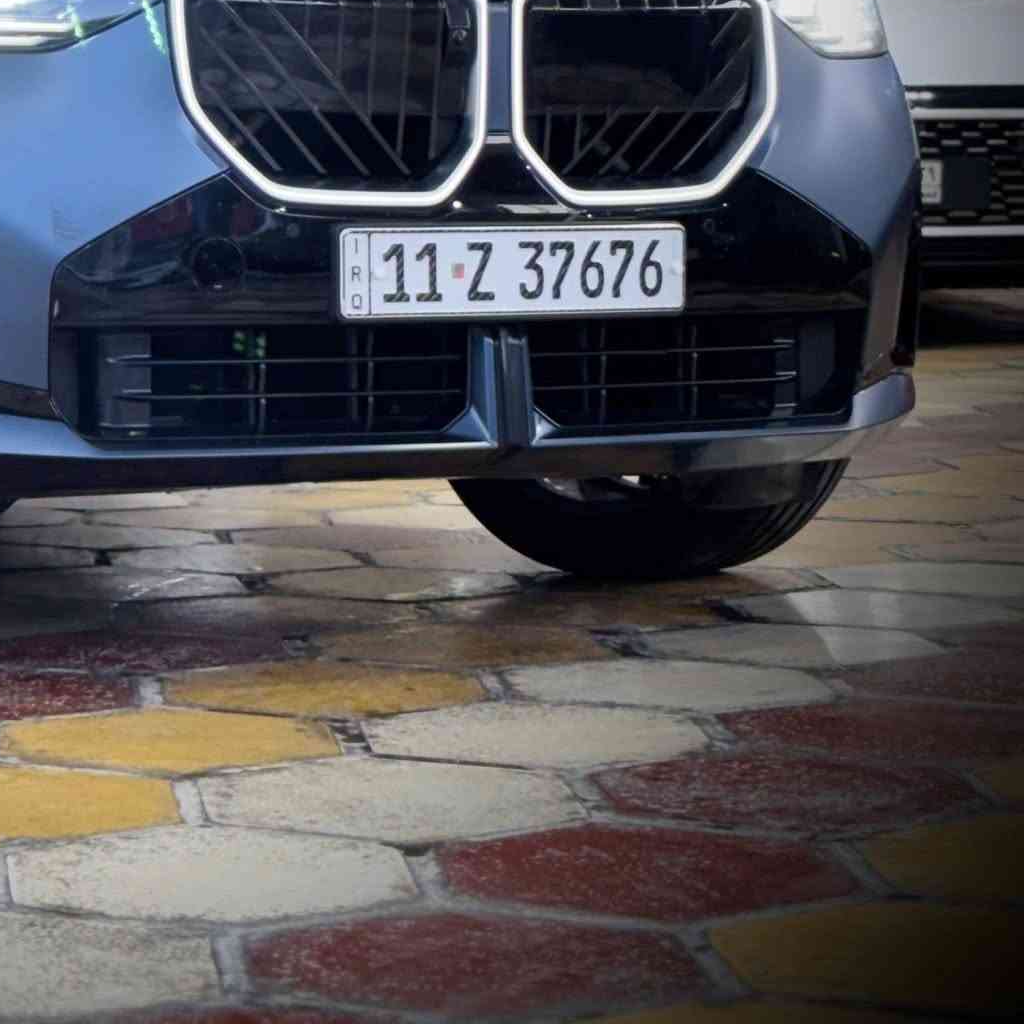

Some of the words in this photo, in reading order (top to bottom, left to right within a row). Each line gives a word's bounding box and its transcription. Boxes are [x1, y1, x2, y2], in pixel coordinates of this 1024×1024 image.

[382, 242, 443, 303] 11
[466, 241, 496, 301] Z
[518, 239, 664, 300] 37676
